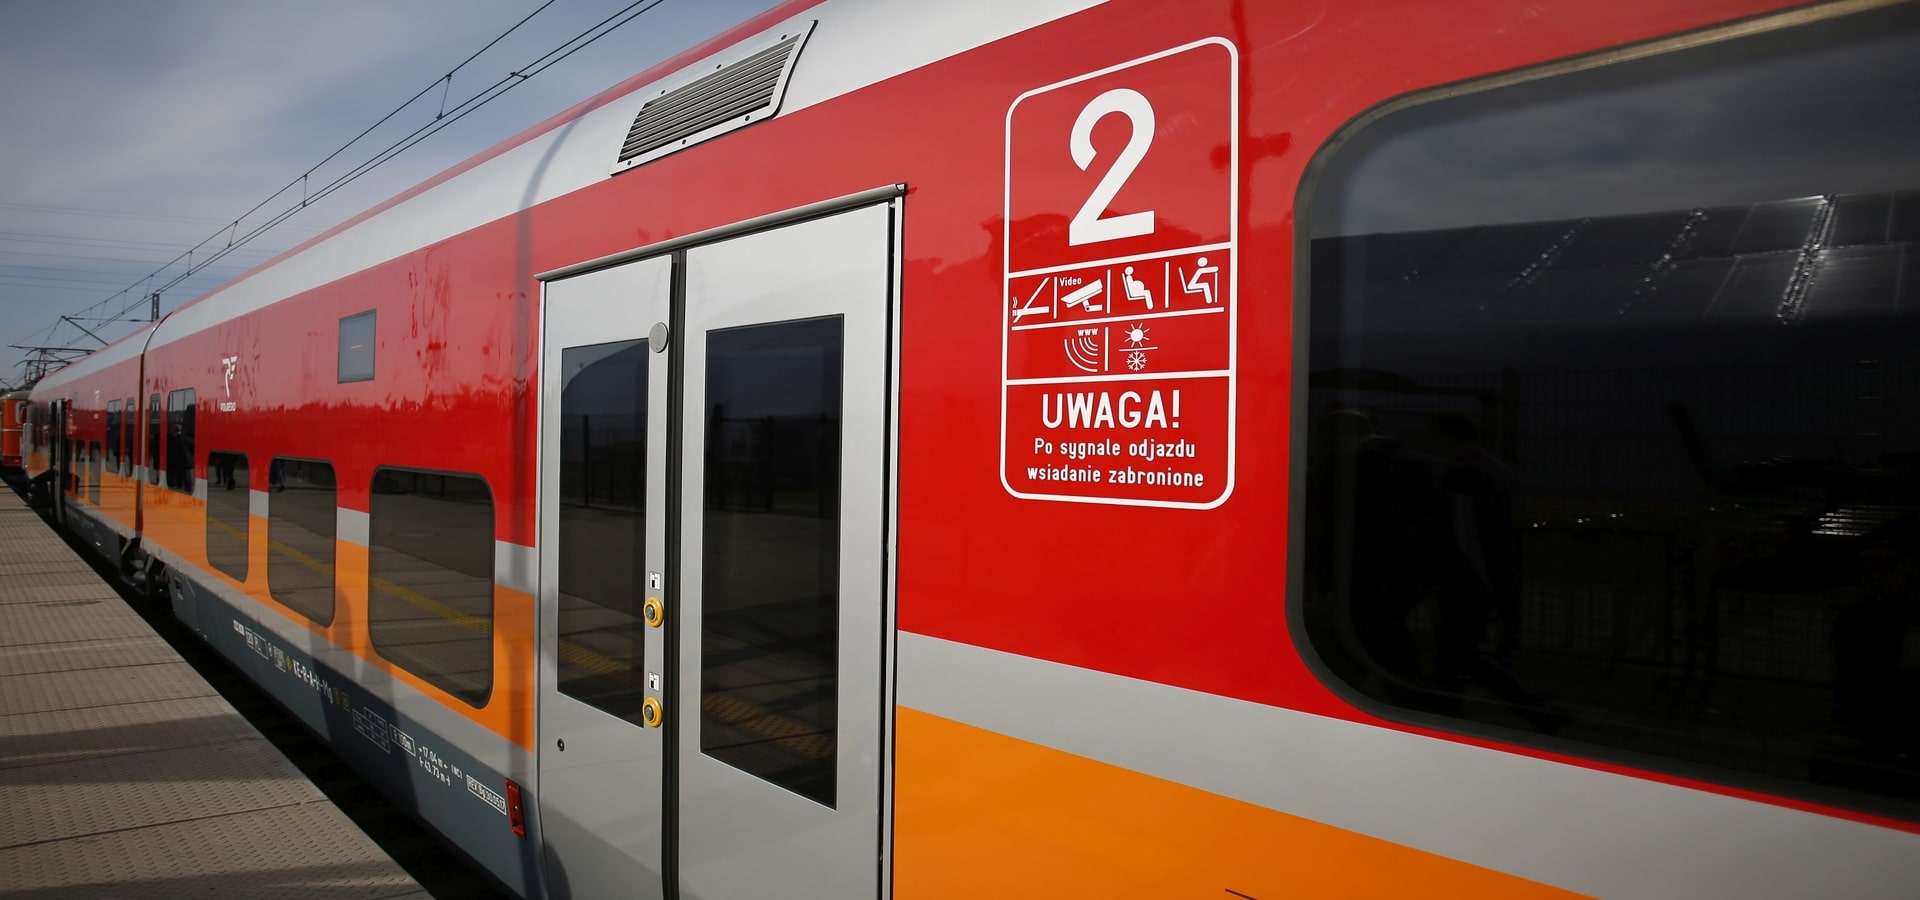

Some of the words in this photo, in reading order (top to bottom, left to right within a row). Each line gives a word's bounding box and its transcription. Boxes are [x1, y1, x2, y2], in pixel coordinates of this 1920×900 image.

[1069, 88, 1156, 247] 2
[1059, 276, 1082, 287] Video
[1077, 328, 1098, 336] www
[1042, 389, 1180, 429] UWAGA!
[1034, 437, 1053, 455] Po
[1060, 438, 1121, 459] sygnale
[1128, 438, 1196, 462] odjazdu
[1027, 464, 1101, 483] wsiadanie
[1108, 466, 1204, 487] zabronione
